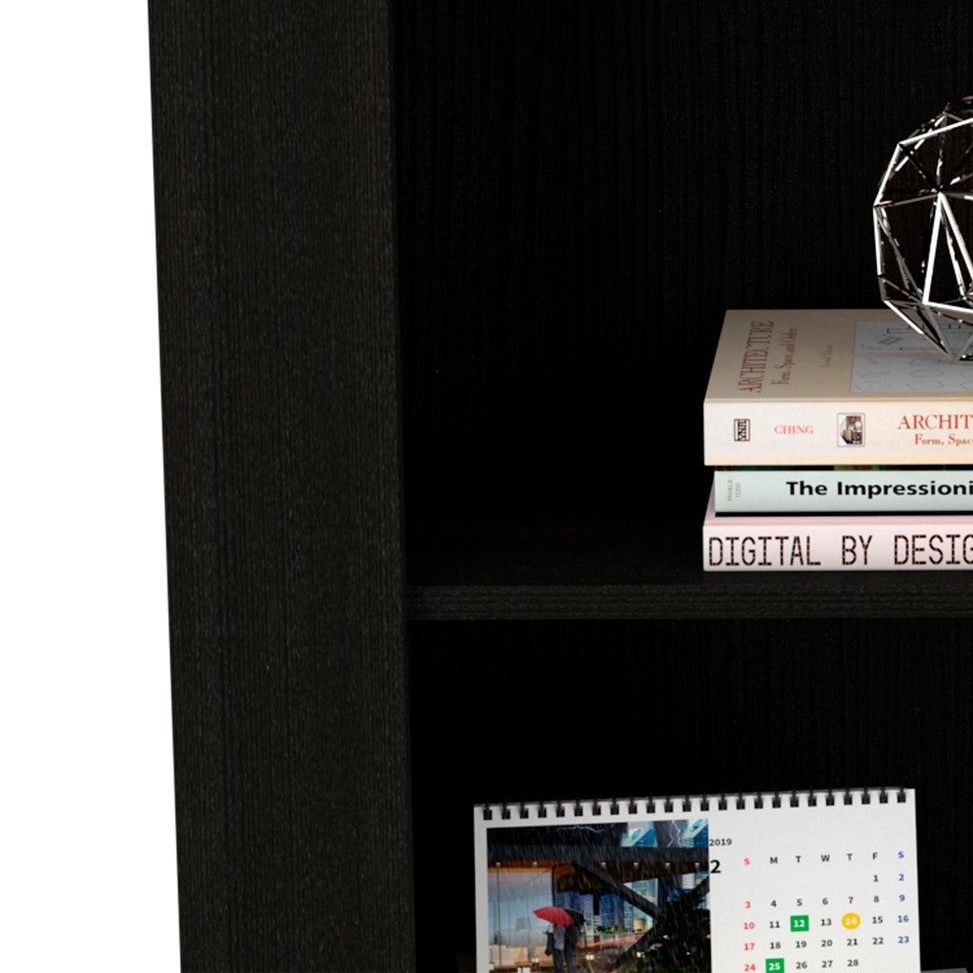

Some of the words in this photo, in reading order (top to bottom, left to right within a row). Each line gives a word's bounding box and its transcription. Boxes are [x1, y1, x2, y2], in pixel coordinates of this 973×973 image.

[738, 321, 774, 393] ARCHITECTURE
[774, 425, 814, 435] CHING
[914, 433, 945, 446] Form,
[786, 481, 828, 496] The
[708, 535, 821, 566] DIGITAL
[841, 535, 873, 565] BY
[709, 838, 732, 846] 2019
[821, 854, 830, 862] W
[847, 853, 853, 861] T
[873, 852, 878, 860] F
[898, 851, 904, 859] S
[710, 859, 721, 874] 2
[899, 873, 904, 881] 2
[745, 901, 751, 909] 3
[797, 899, 802, 907] 5
[822, 897, 828, 906] 6
[848, 896, 853, 904] 7
[874, 895, 879, 903] 8
[899, 894, 905, 902] 9
[744, 922, 755, 930] 10
[769, 921, 780, 929] 11
[794, 920, 805, 928] 12
[821, 919, 832, 927] 13
[845, 917, 857, 925] 14
[872, 916, 883, 924] 15
[898, 915, 909, 923] 16
[744, 943, 755, 951] 17
[770, 942, 781, 950] 18
[796, 941, 807, 949] 19
[821, 939, 833, 947] 20
[846, 938, 857, 946] 21
[872, 937, 884, 945] 22
[898, 936, 909, 944] 23
[744, 964, 756, 972] 24
[769, 962, 780, 971] 25
[796, 962, 807, 970] 26
[822, 960, 833, 968] 27
[847, 959, 859, 967] 28
